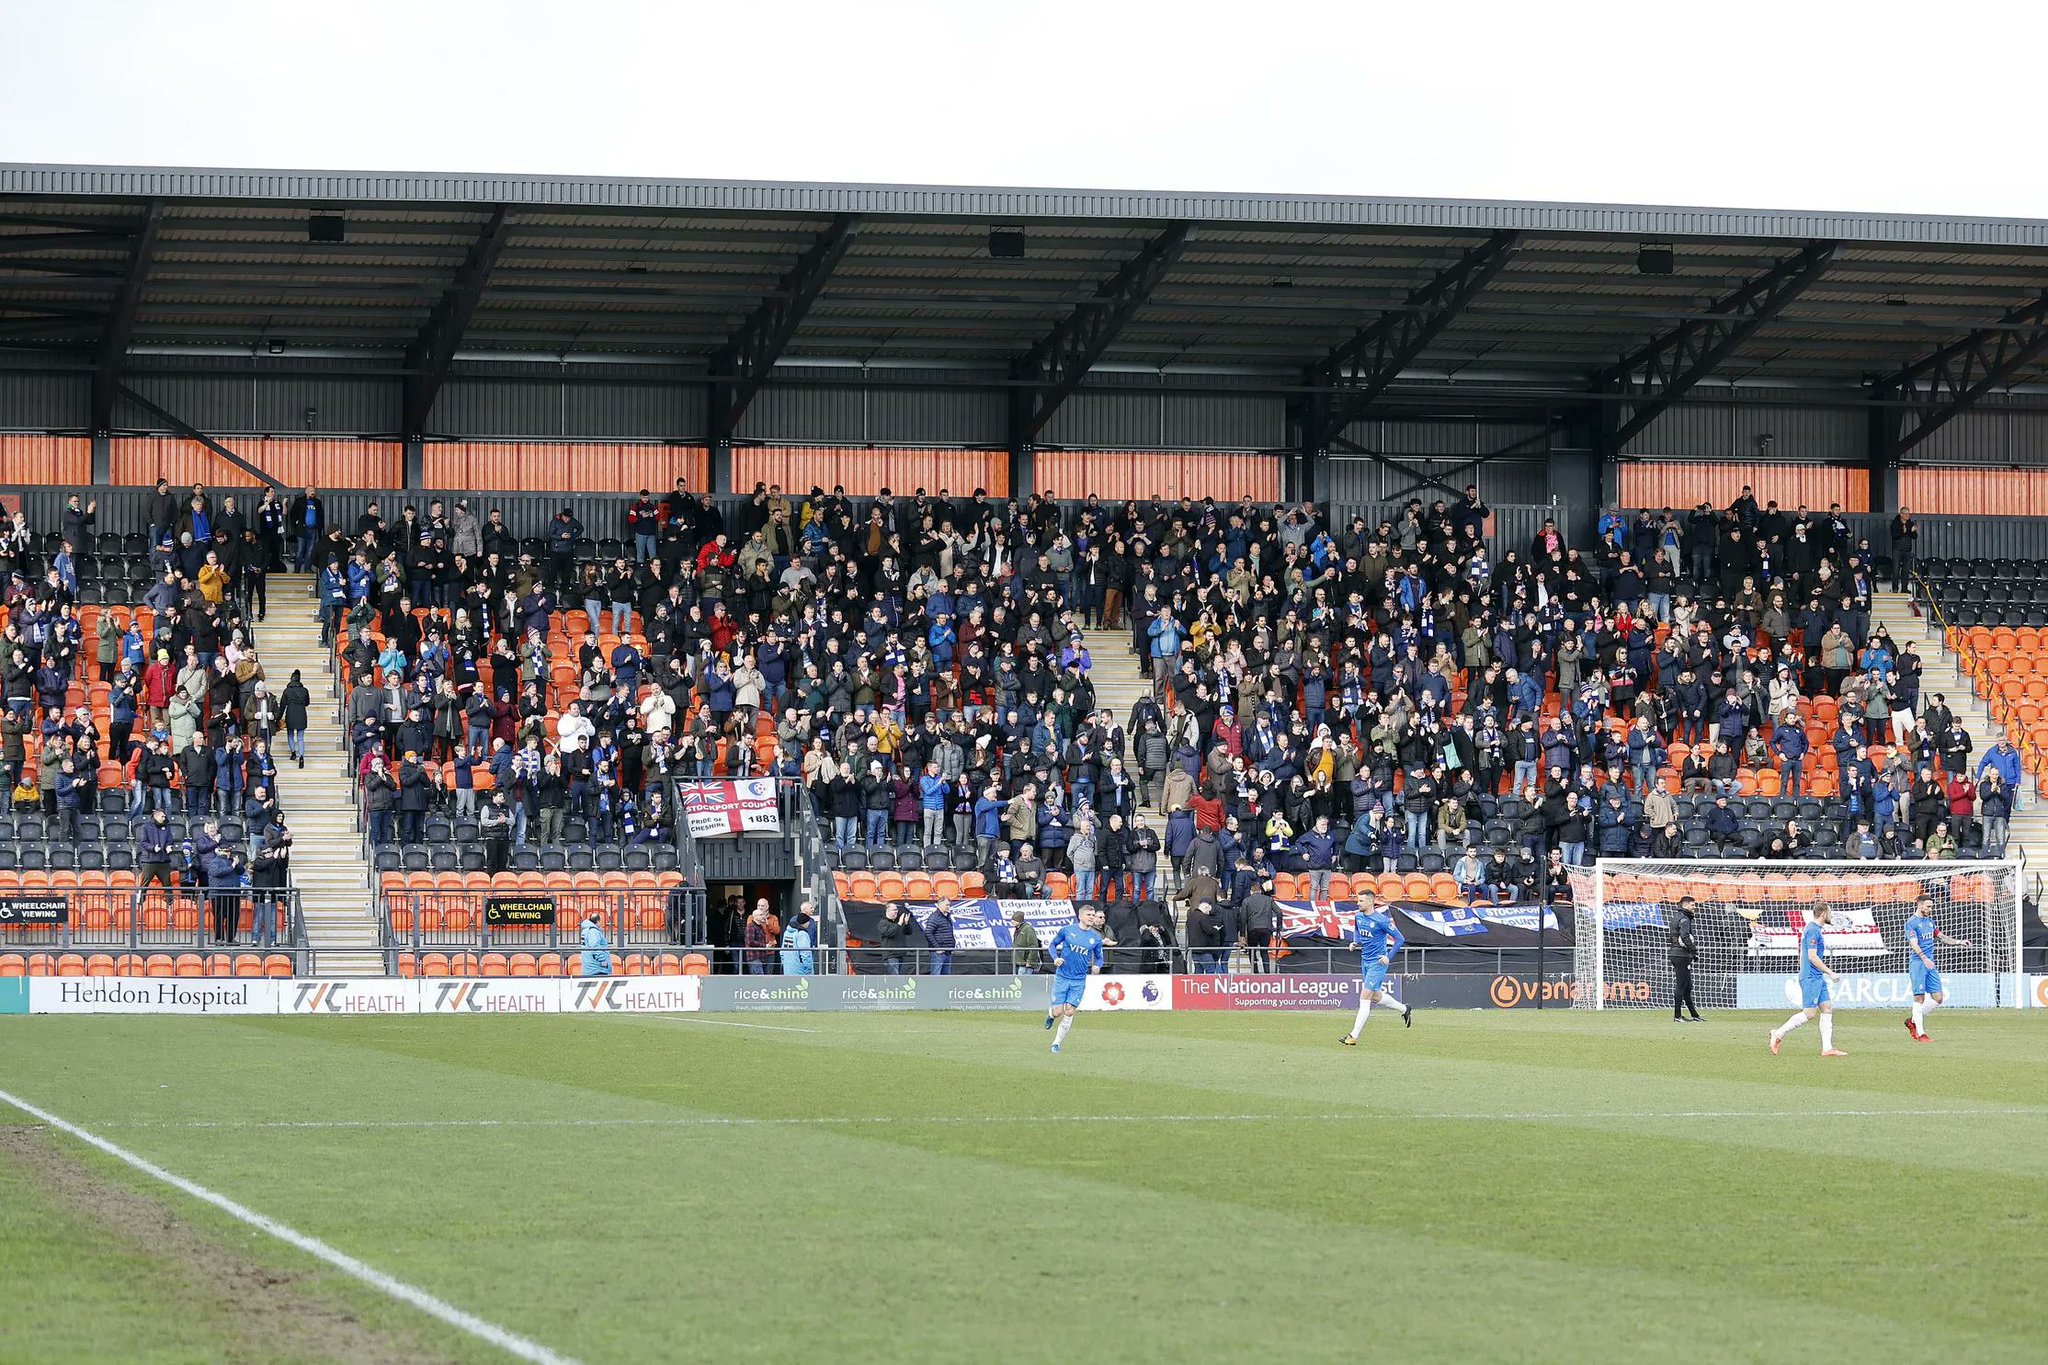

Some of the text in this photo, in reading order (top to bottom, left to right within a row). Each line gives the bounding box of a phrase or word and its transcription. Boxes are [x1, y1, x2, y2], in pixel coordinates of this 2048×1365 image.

[686, 800, 777, 813] STOCKPORT COUNTY
[748, 815, 777, 823] 1883
[691, 823, 725, 832] CHESHIRE
[1000, 900, 1042, 908] Edgeley
[959, 920, 987, 928] and
[1069, 944, 1089, 956] VITA
[1181, 979, 1210, 994] The
[1214, 978, 1287, 994] National
[1290, 978, 1349, 997] League
[60, 981, 248, 1011] Hendon Hospital
[734, 988, 809, 999] rice&shine
[842, 988, 916, 999] rice&shine
[949, 988, 1022, 999] rice&shine
[345, 995, 405, 1011] HEALTH
[487, 995, 545, 1011] HEALTH
[626, 992, 684, 1009] HEALTH
[1234, 997, 1342, 1007] Supporting your community
